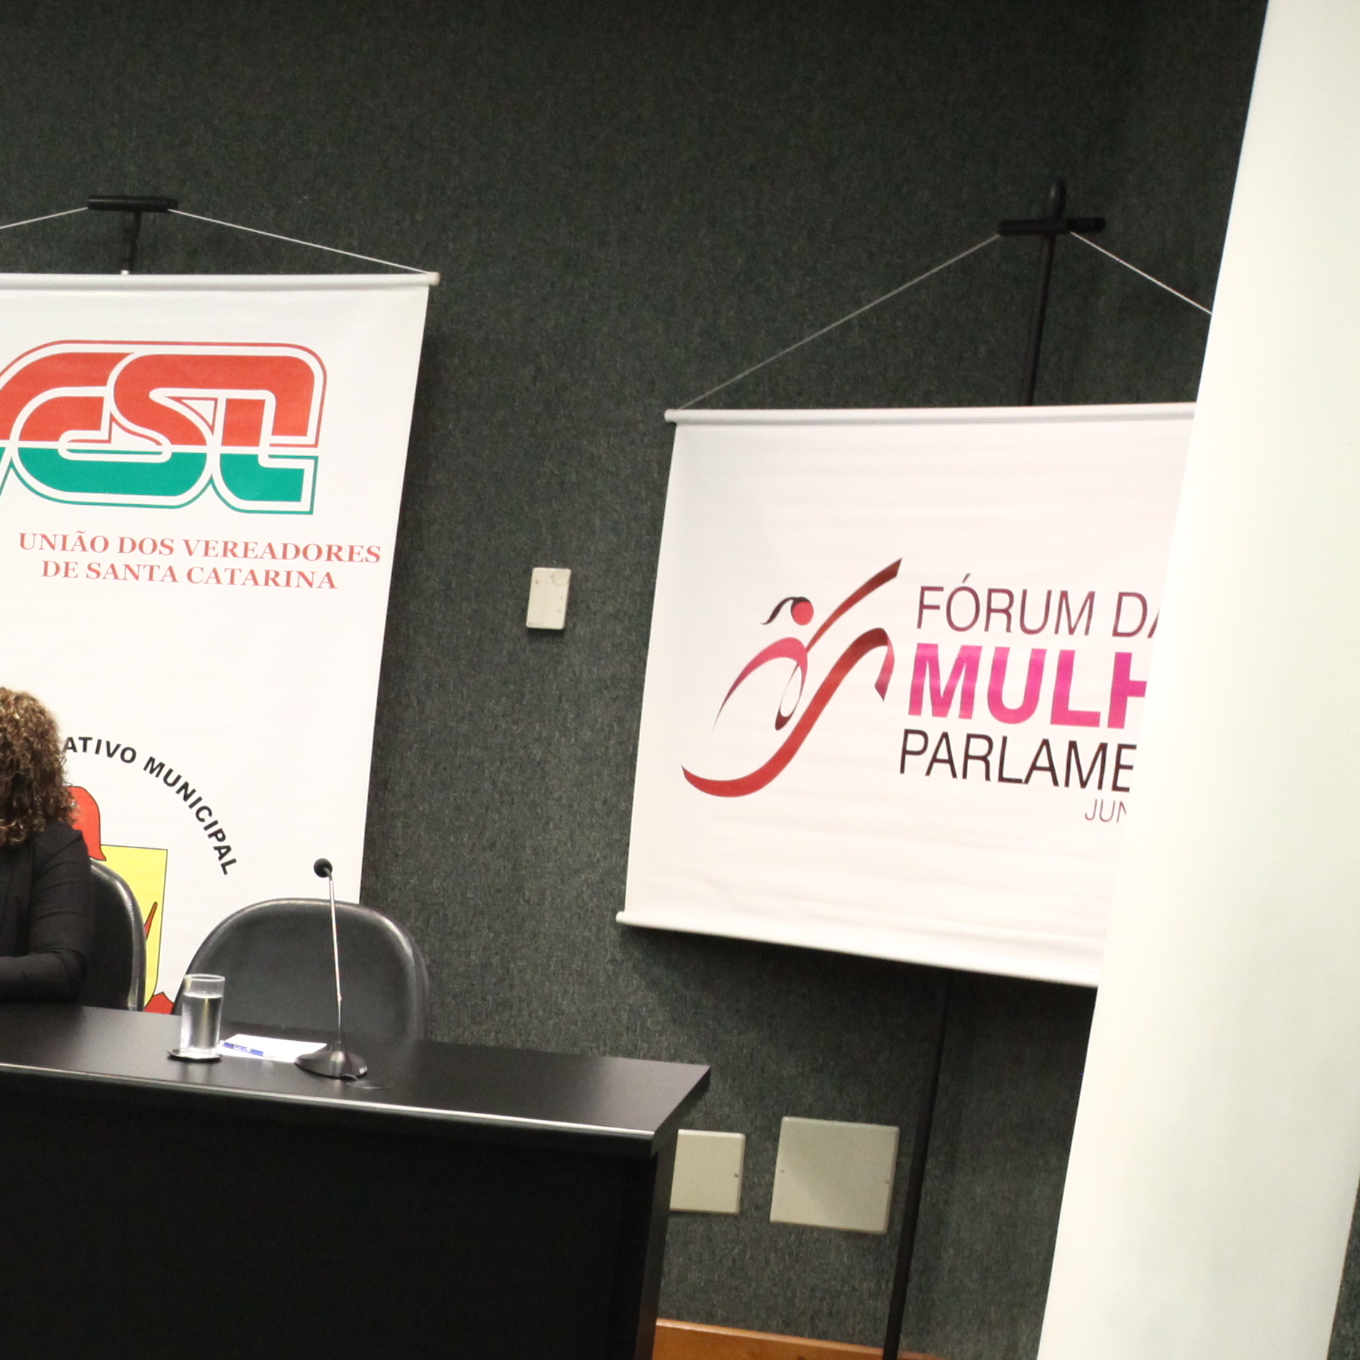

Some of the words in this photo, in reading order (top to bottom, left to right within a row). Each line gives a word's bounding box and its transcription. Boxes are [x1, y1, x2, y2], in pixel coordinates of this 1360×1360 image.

[18, 530, 109, 554] UNIÃO
[117, 535, 175, 557] DOS
[182, 538, 381, 564] VEREADORES
[41, 559, 80, 579] DE
[85, 561, 179, 584] SANTA
[185, 565, 339, 590] CATARINA
[916, 573, 1097, 638] FÓRUM
[907, 642, 1148, 730] MULH
[899, 728, 1138, 794] PARLAME
[142, 755, 238, 876] MUNICIPAL
